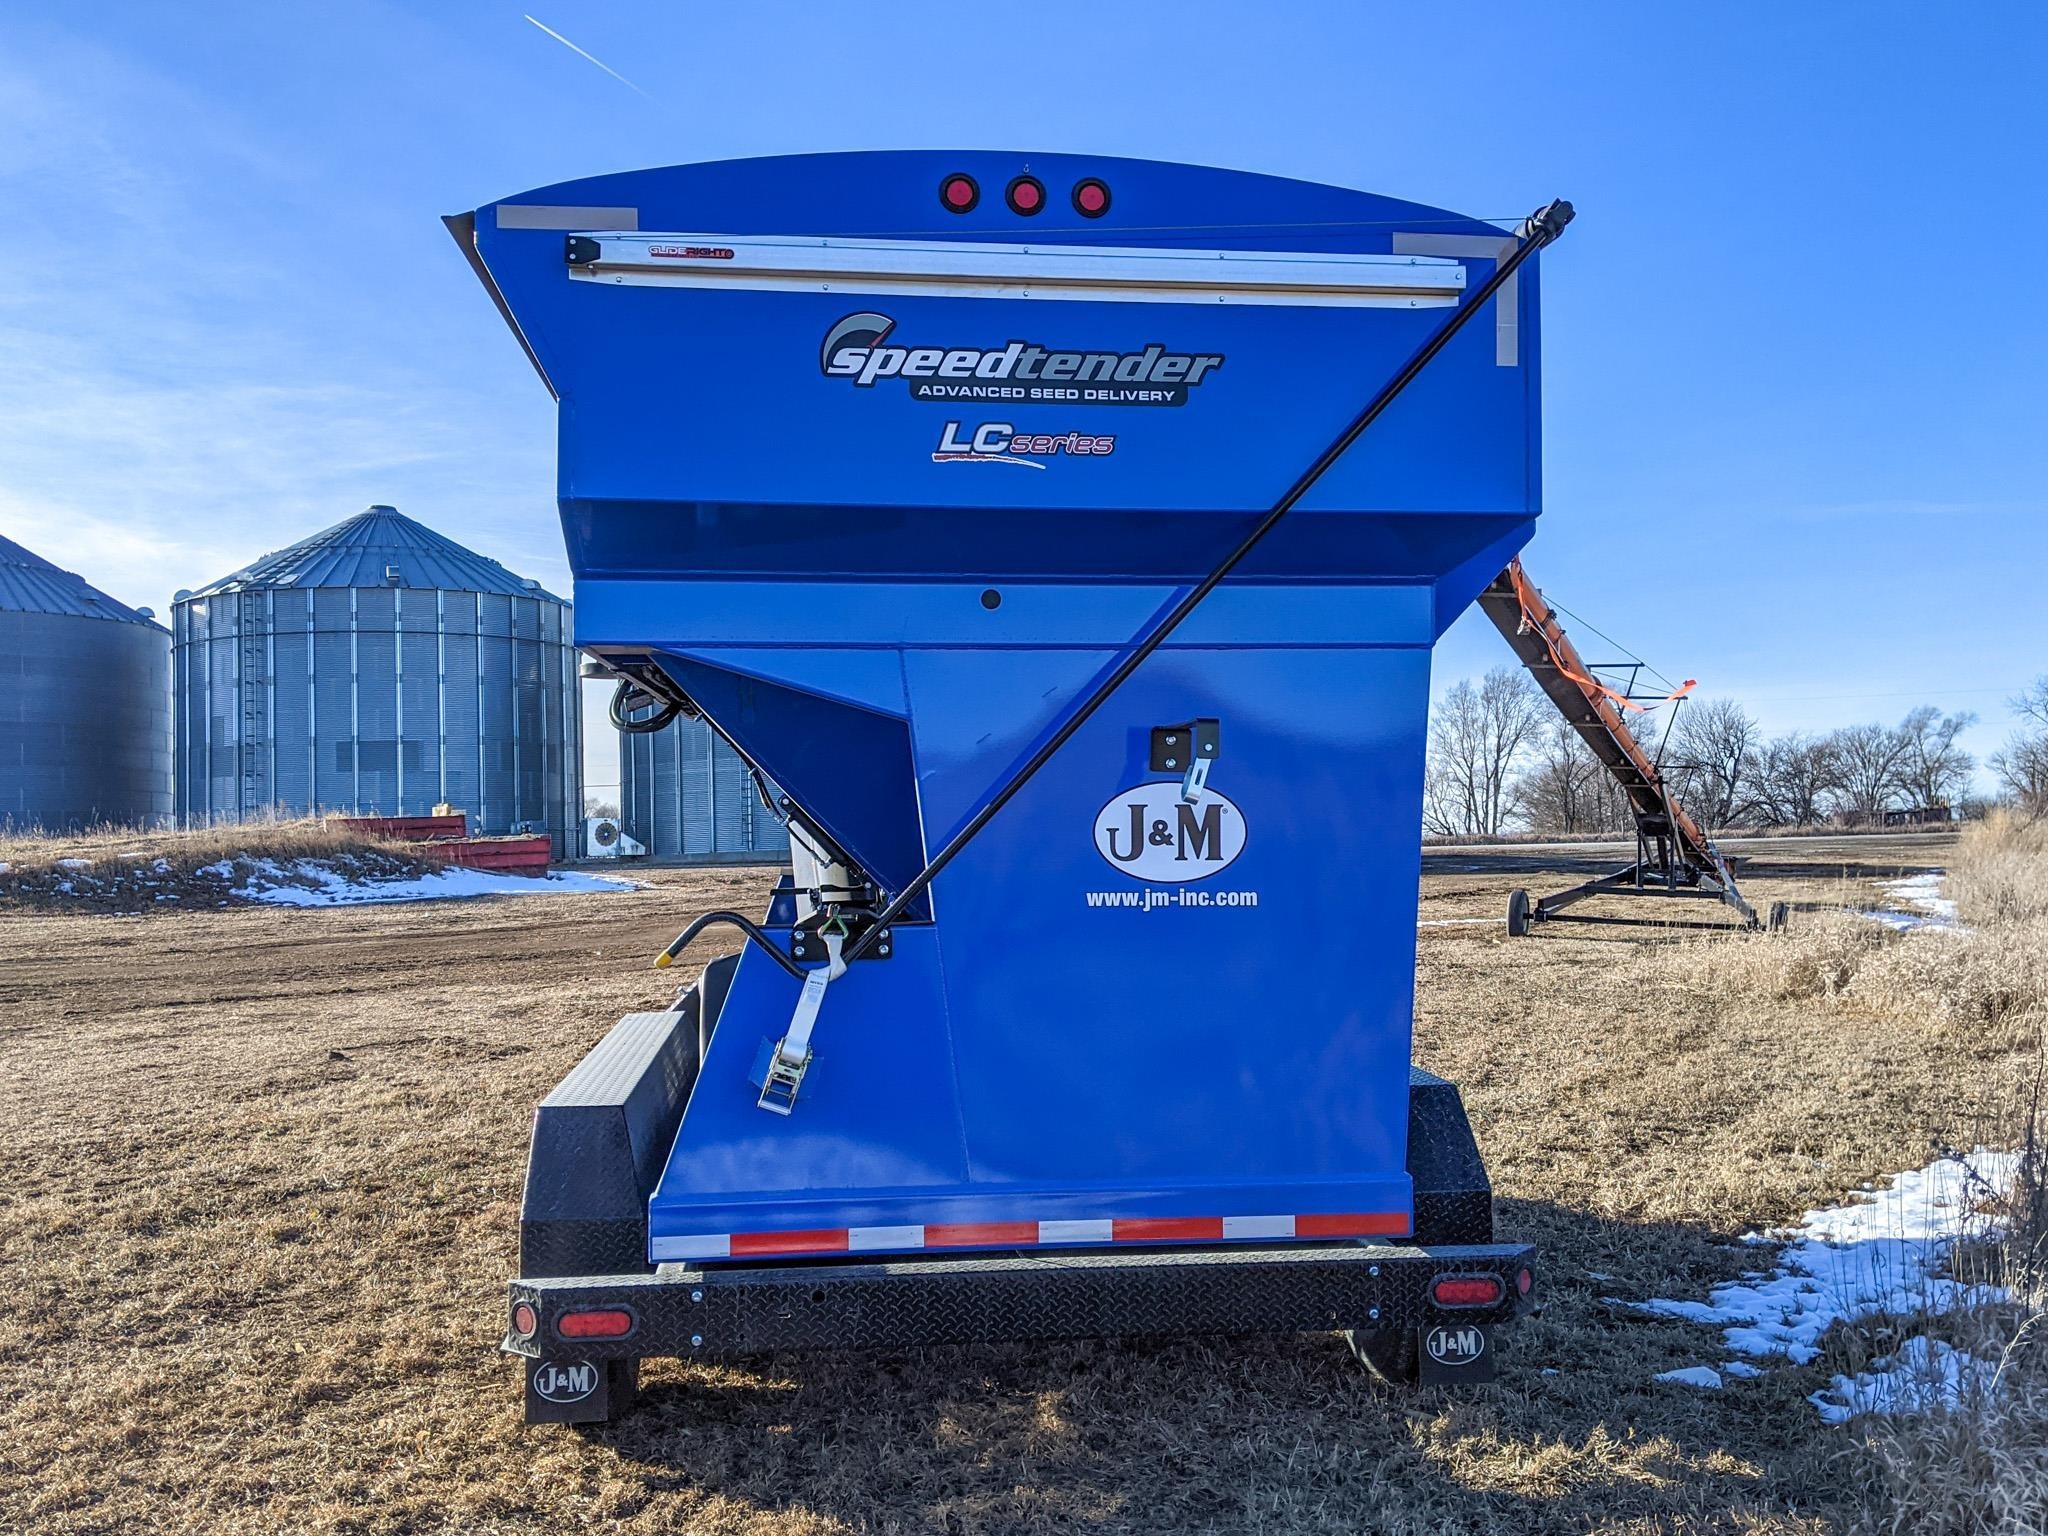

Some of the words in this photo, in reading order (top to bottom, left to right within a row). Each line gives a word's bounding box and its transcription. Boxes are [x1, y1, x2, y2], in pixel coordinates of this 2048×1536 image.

[918, 385, 1025, 399] ADVANCED
[1030, 388, 1079, 400] SEED
[1084, 390, 1176, 402] DELIVERY
[1086, 888, 1258, 912] www.jm-inc.com
[1430, 1330, 1477, 1357] J&M
[538, 1366, 589, 1394] J&M
